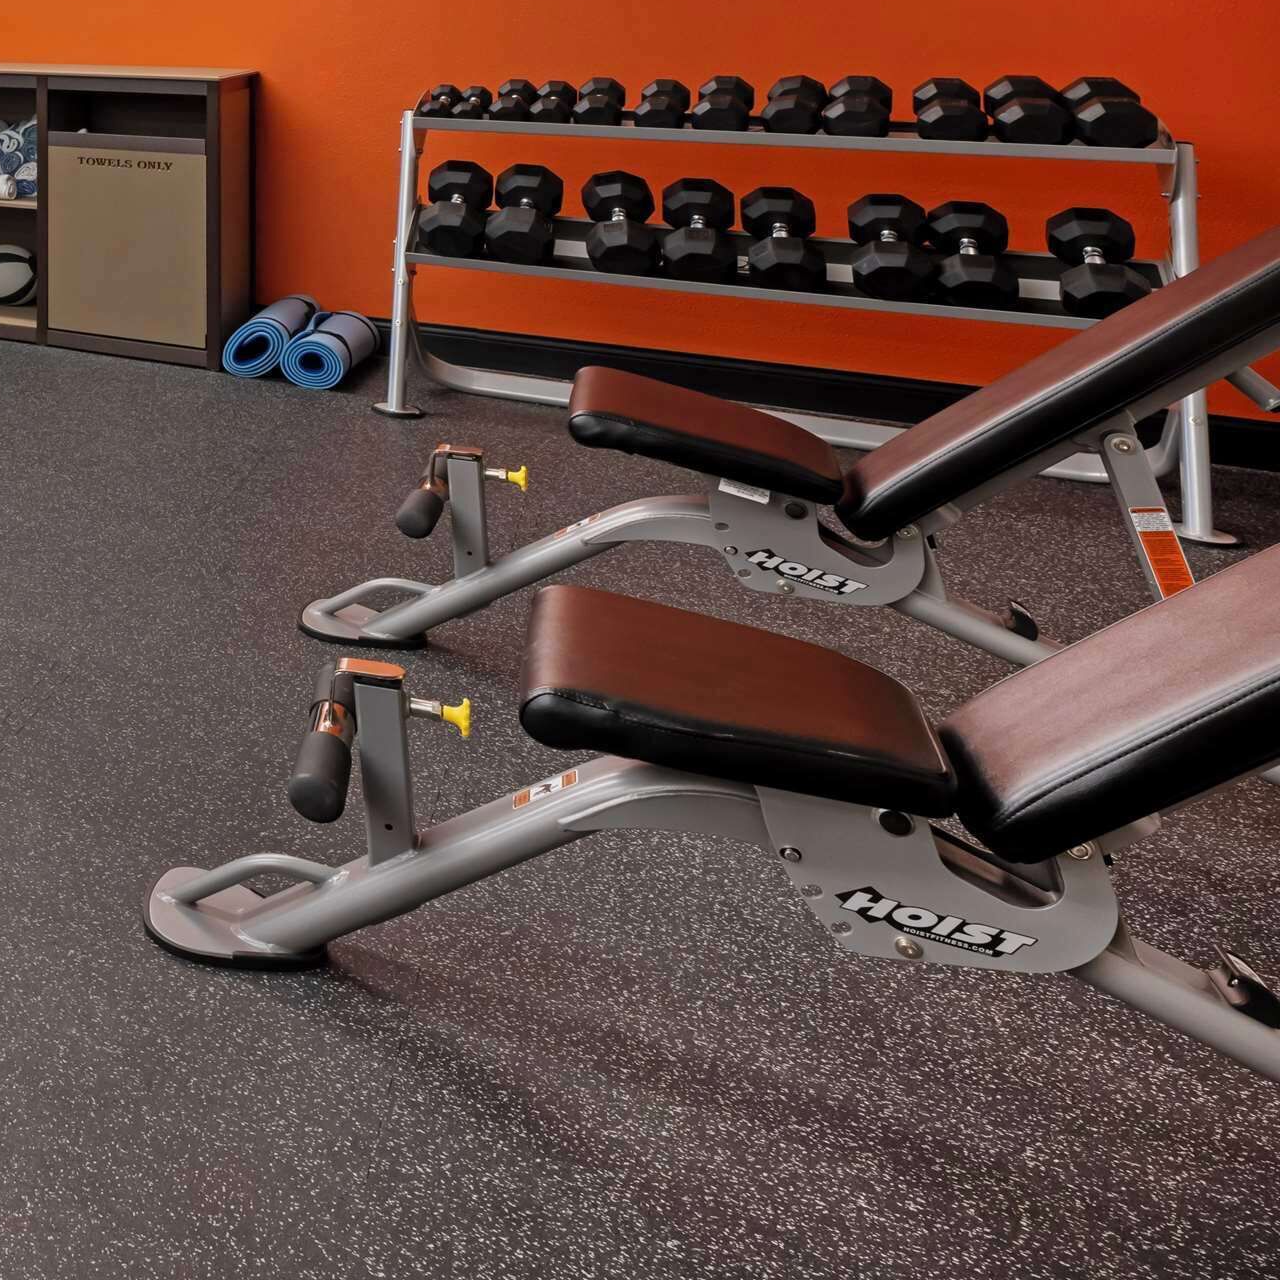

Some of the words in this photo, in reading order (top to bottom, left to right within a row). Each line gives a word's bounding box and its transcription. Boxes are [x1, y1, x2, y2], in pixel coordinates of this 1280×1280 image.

[77, 156, 133, 169] TOWELS
[137, 160, 173, 171] ONLY
[746, 551, 869, 594] HOIST
[840, 890, 1038, 955] HOIST
[902, 926, 994, 955] HOISTFITNESS.COM
